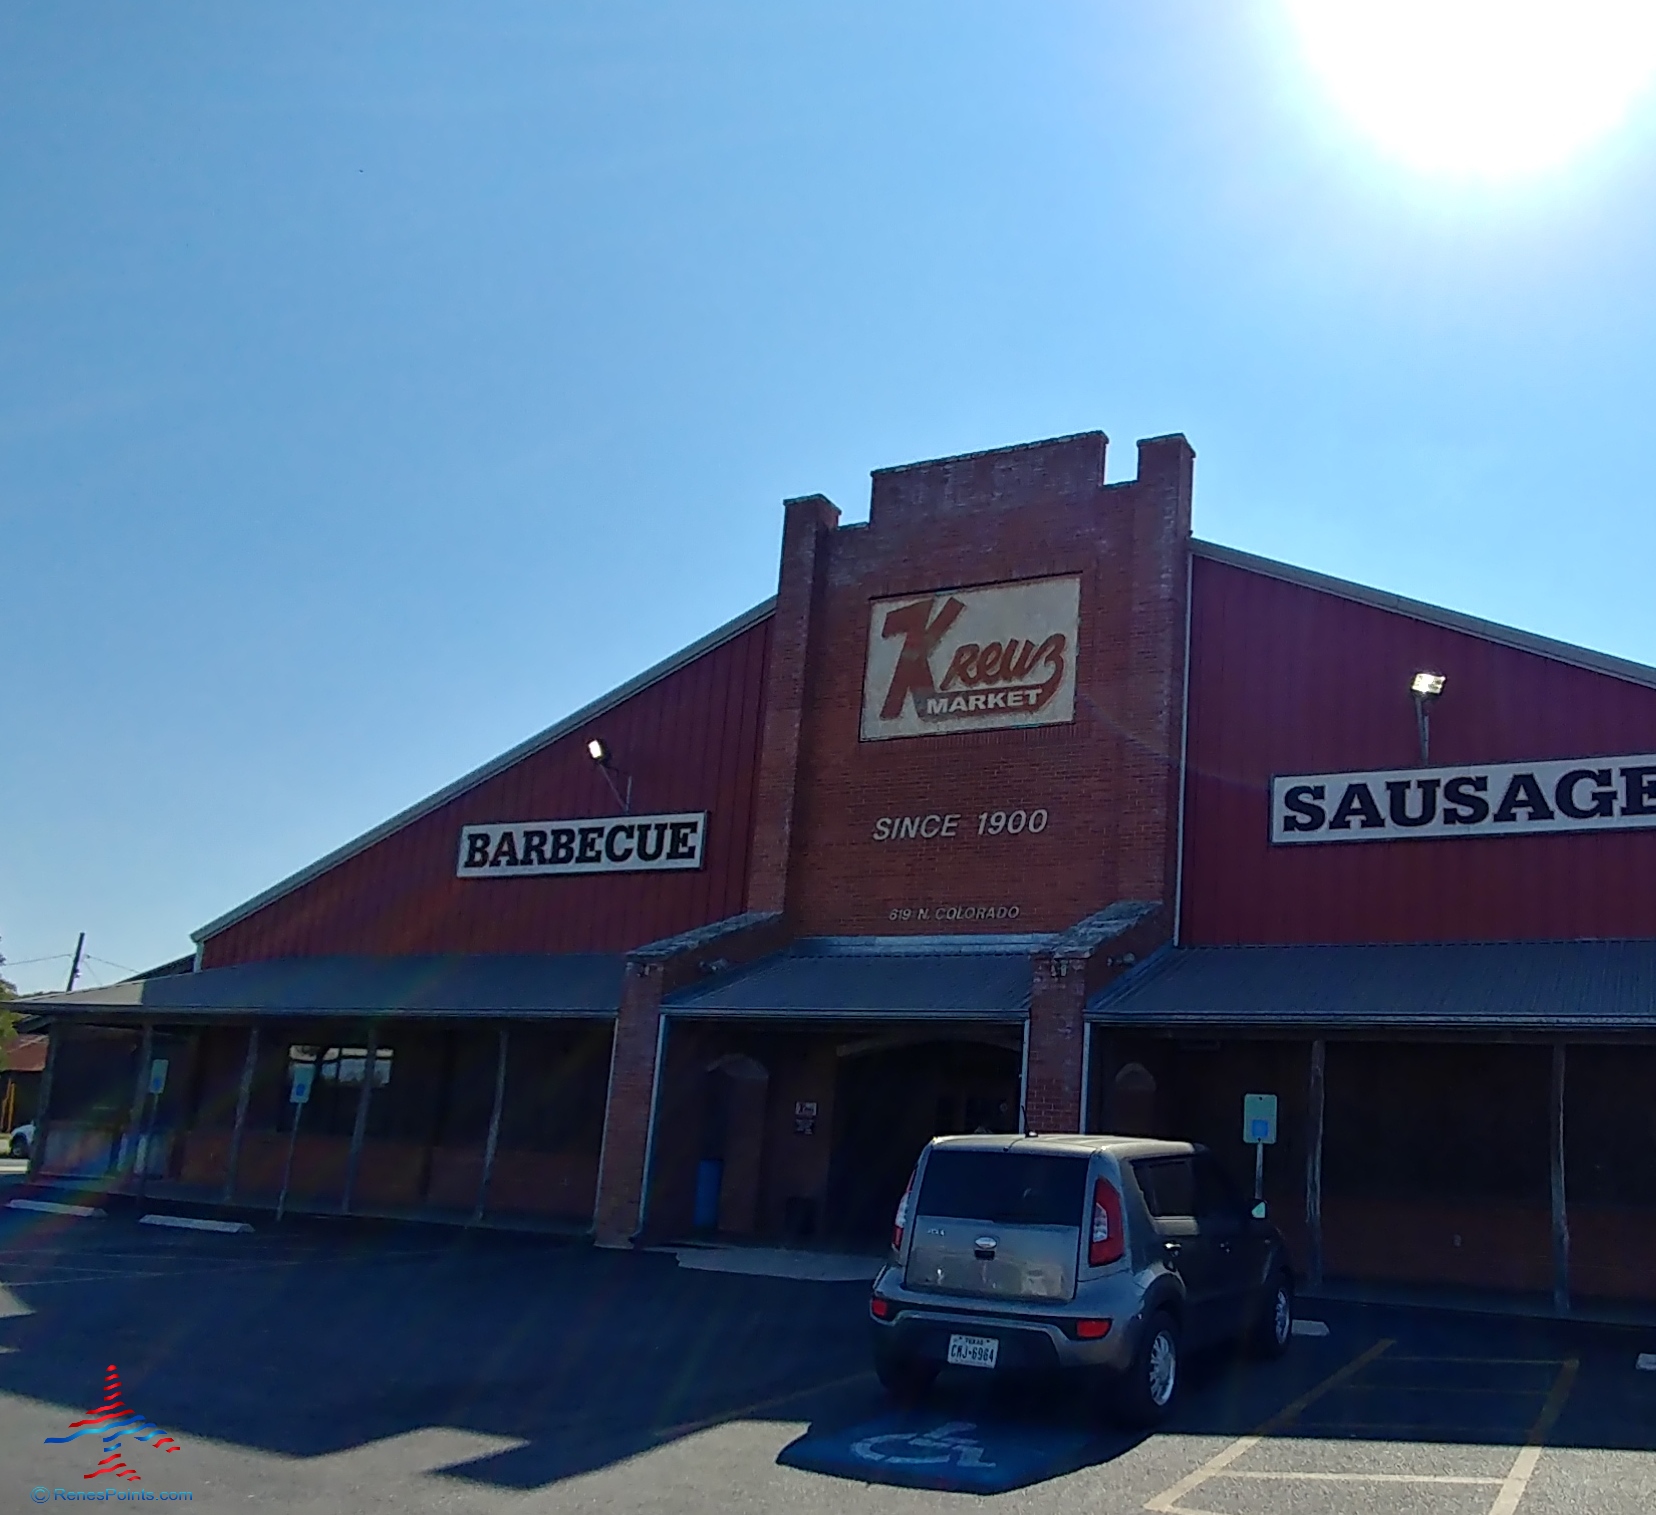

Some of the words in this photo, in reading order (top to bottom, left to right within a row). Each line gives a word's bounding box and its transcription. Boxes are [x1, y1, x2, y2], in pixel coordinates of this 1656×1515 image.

[926, 688, 1043, 714] MARKET
[1282, 766, 1656, 832] SAUSAGE
[873, 813, 961, 841] SINCE
[977, 808, 1048, 836] 1900
[463, 820, 698, 869] BARBECUE
[889, 907, 912, 922] 619
[935, 906, 1020, 921] COLORADO
